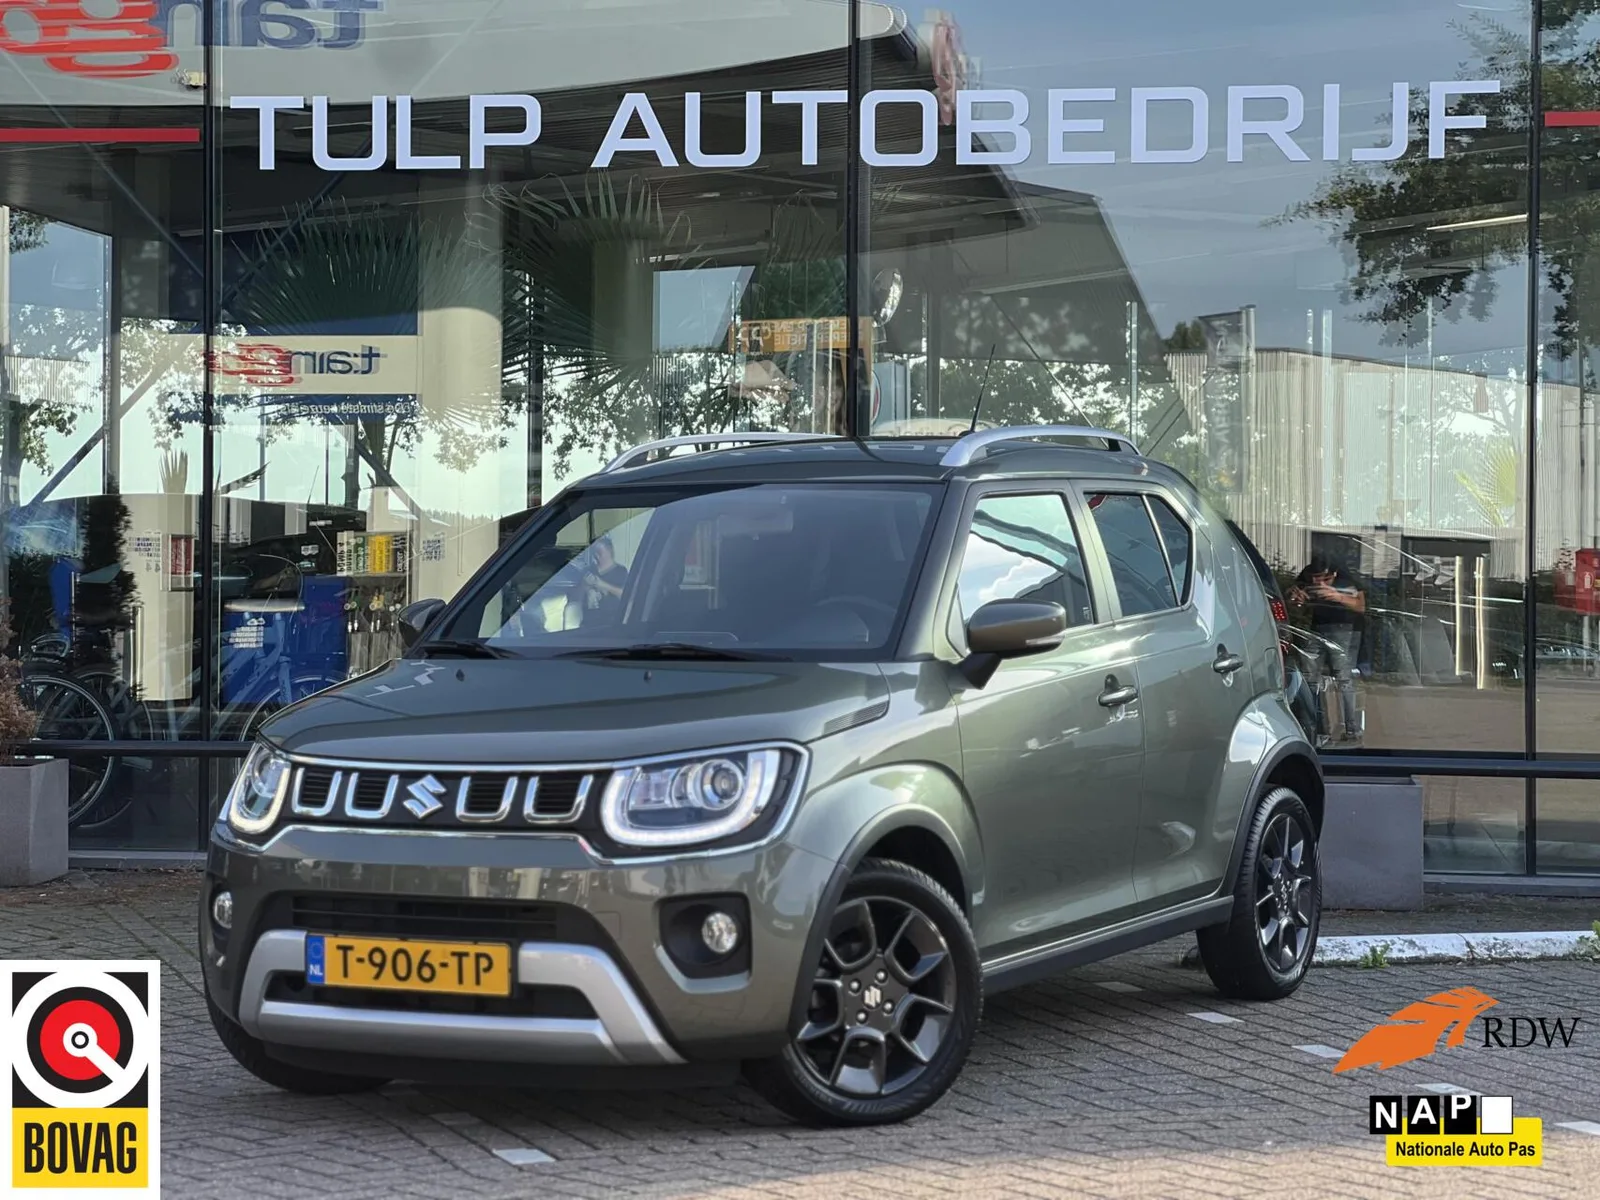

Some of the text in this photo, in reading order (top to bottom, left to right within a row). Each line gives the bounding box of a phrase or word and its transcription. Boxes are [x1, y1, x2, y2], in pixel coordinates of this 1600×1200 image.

[230, 79, 1501, 171] TULP AUTOBEDRIJF
[309, 964, 323, 976] NL
[336, 945, 494, 986] T-906-TP
